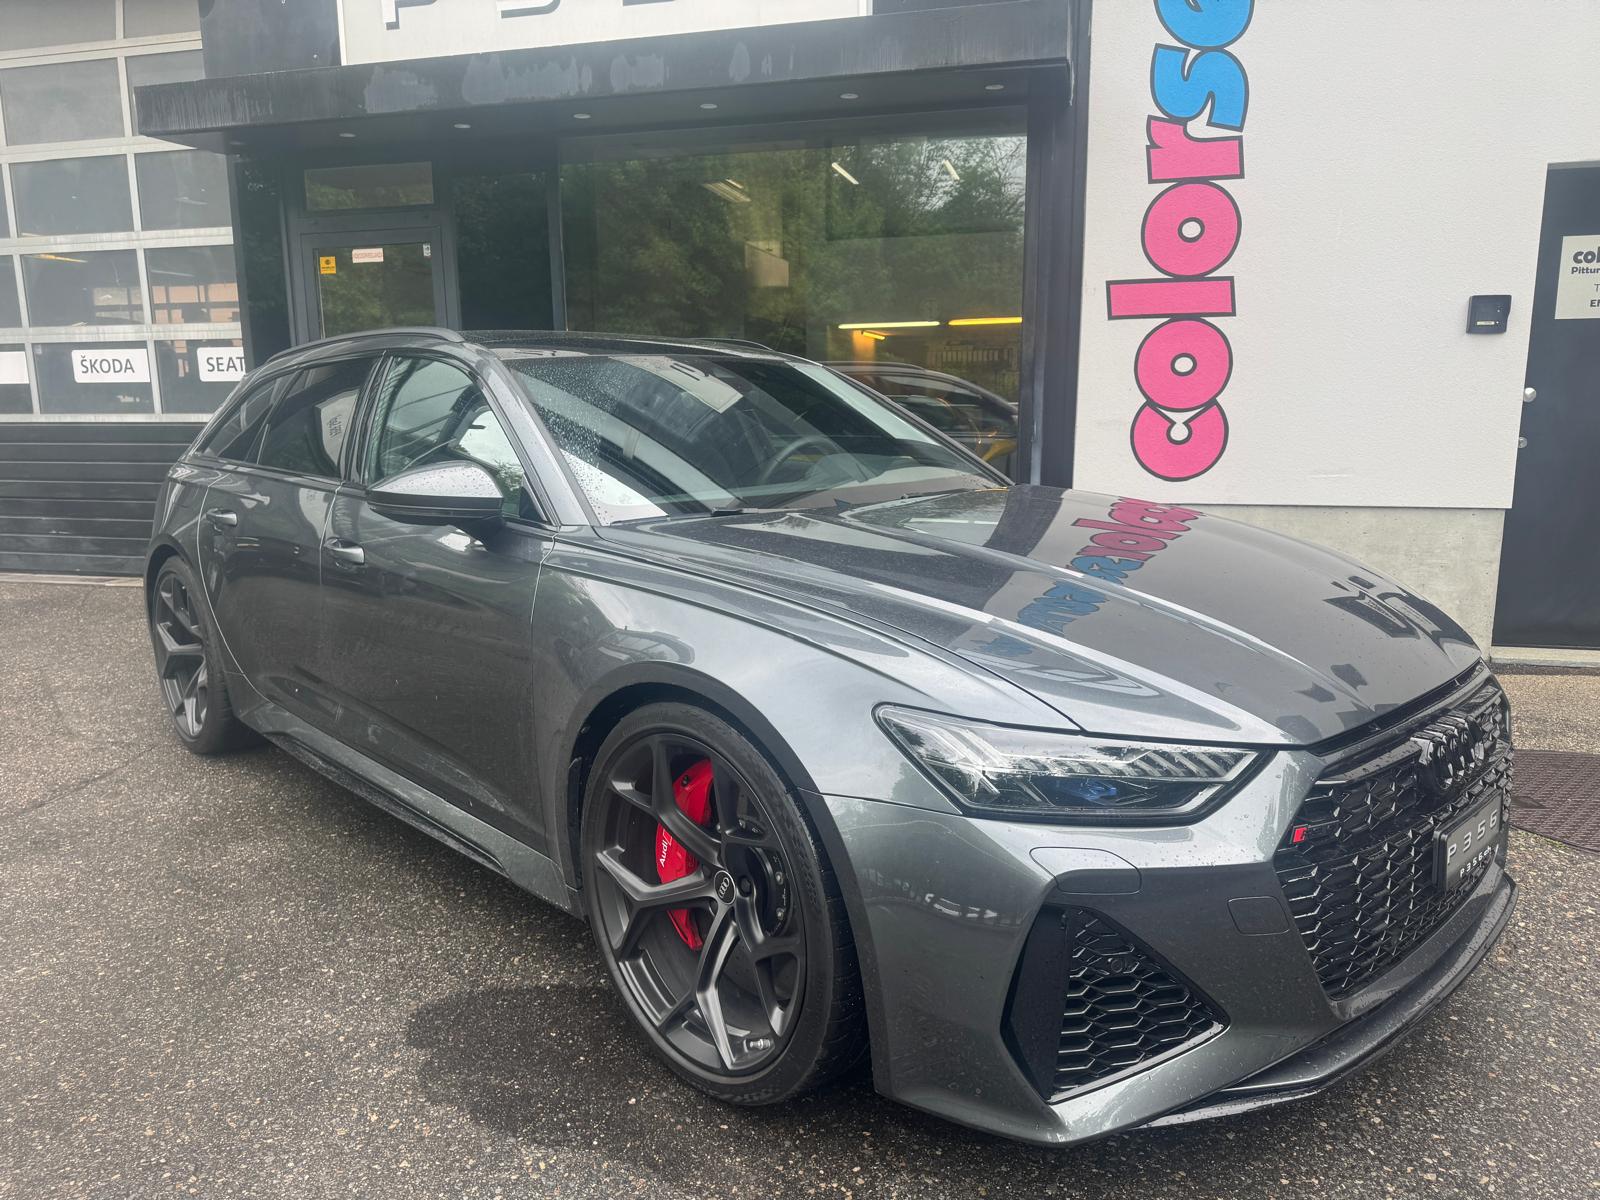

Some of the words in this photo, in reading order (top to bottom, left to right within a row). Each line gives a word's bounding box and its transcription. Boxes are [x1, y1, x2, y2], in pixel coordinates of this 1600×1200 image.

[80, 355, 135, 374] ŠKODA
[206, 356, 246, 372] SEAT
[659, 839, 668, 868] Audi
